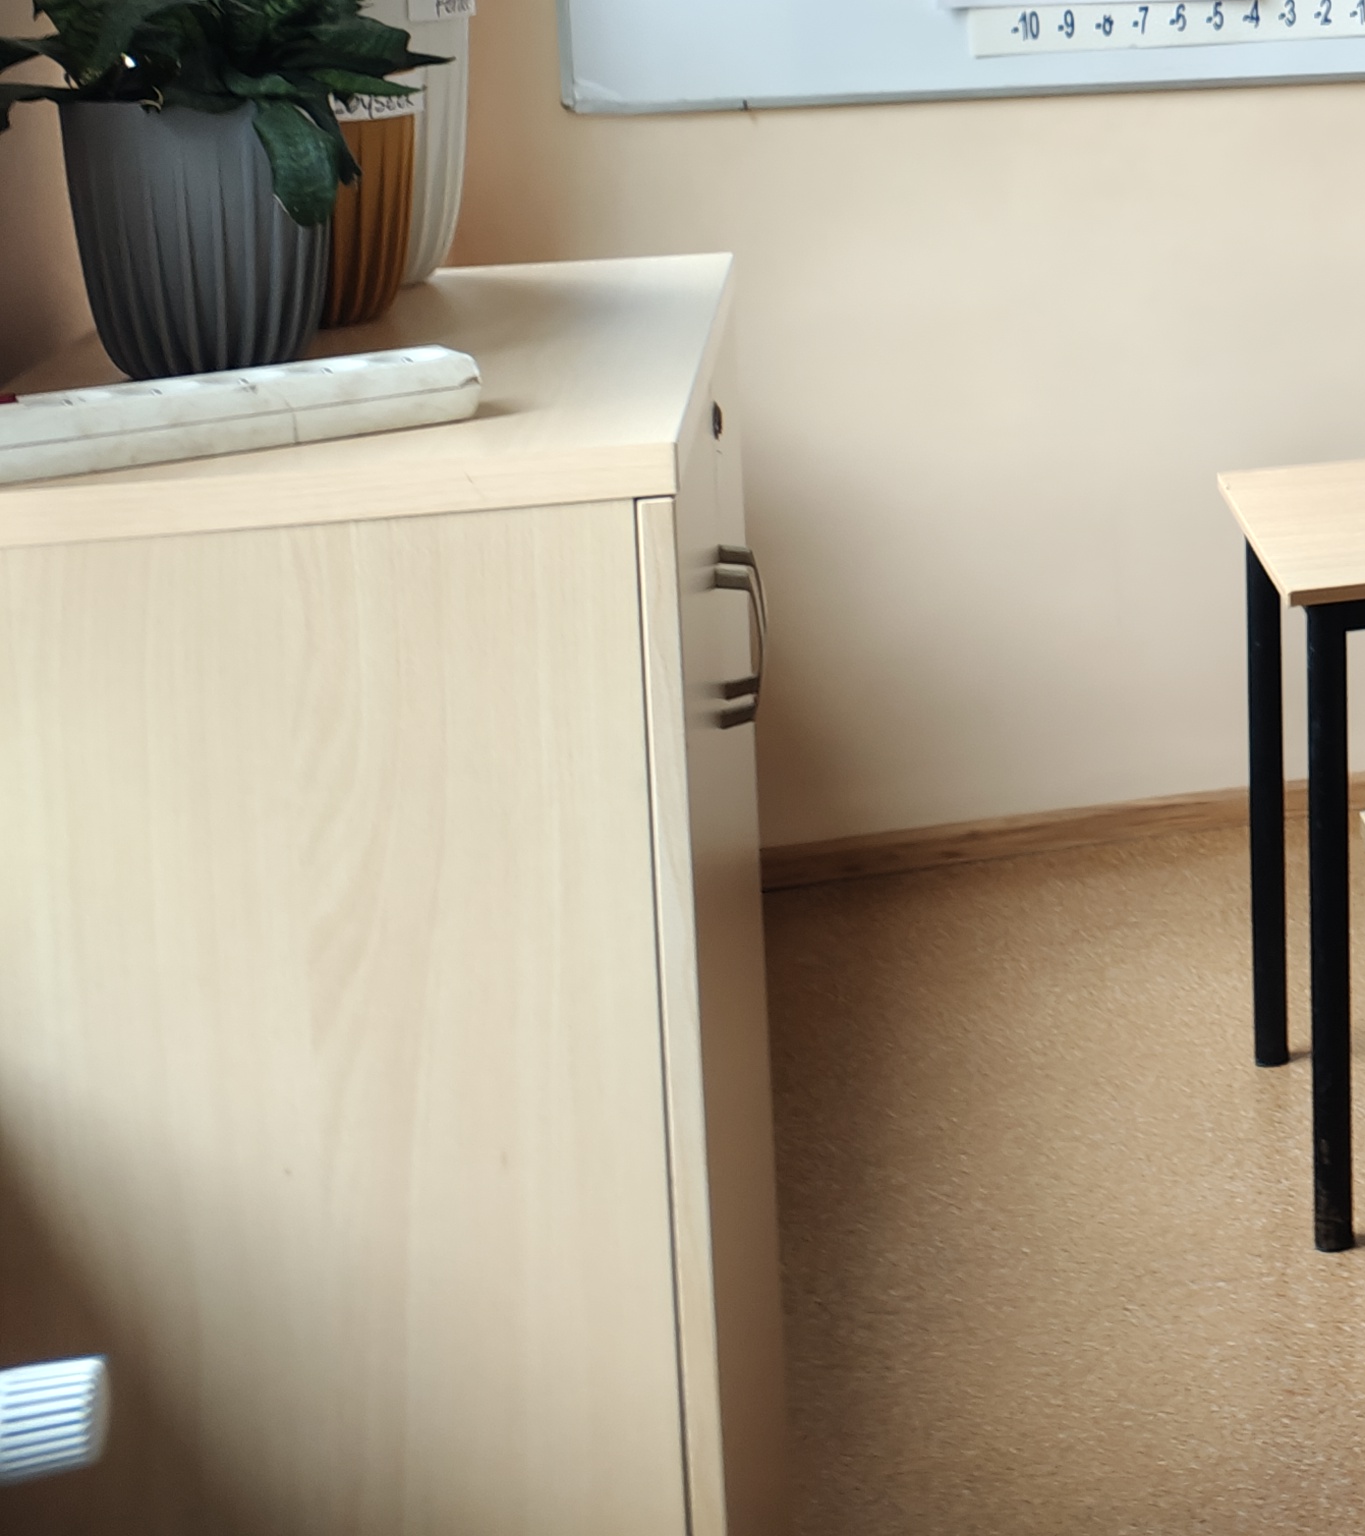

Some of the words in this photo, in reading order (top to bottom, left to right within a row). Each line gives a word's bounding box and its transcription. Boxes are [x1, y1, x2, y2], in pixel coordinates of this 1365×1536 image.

[1011, 11, 1039, 40] -10
[1057, 9, 1075, 38] -9
[1132, 6, 1148, 34] -7
[1169, 4, 1187, 31] -6
[1206, 1, 1224, 30] -5
